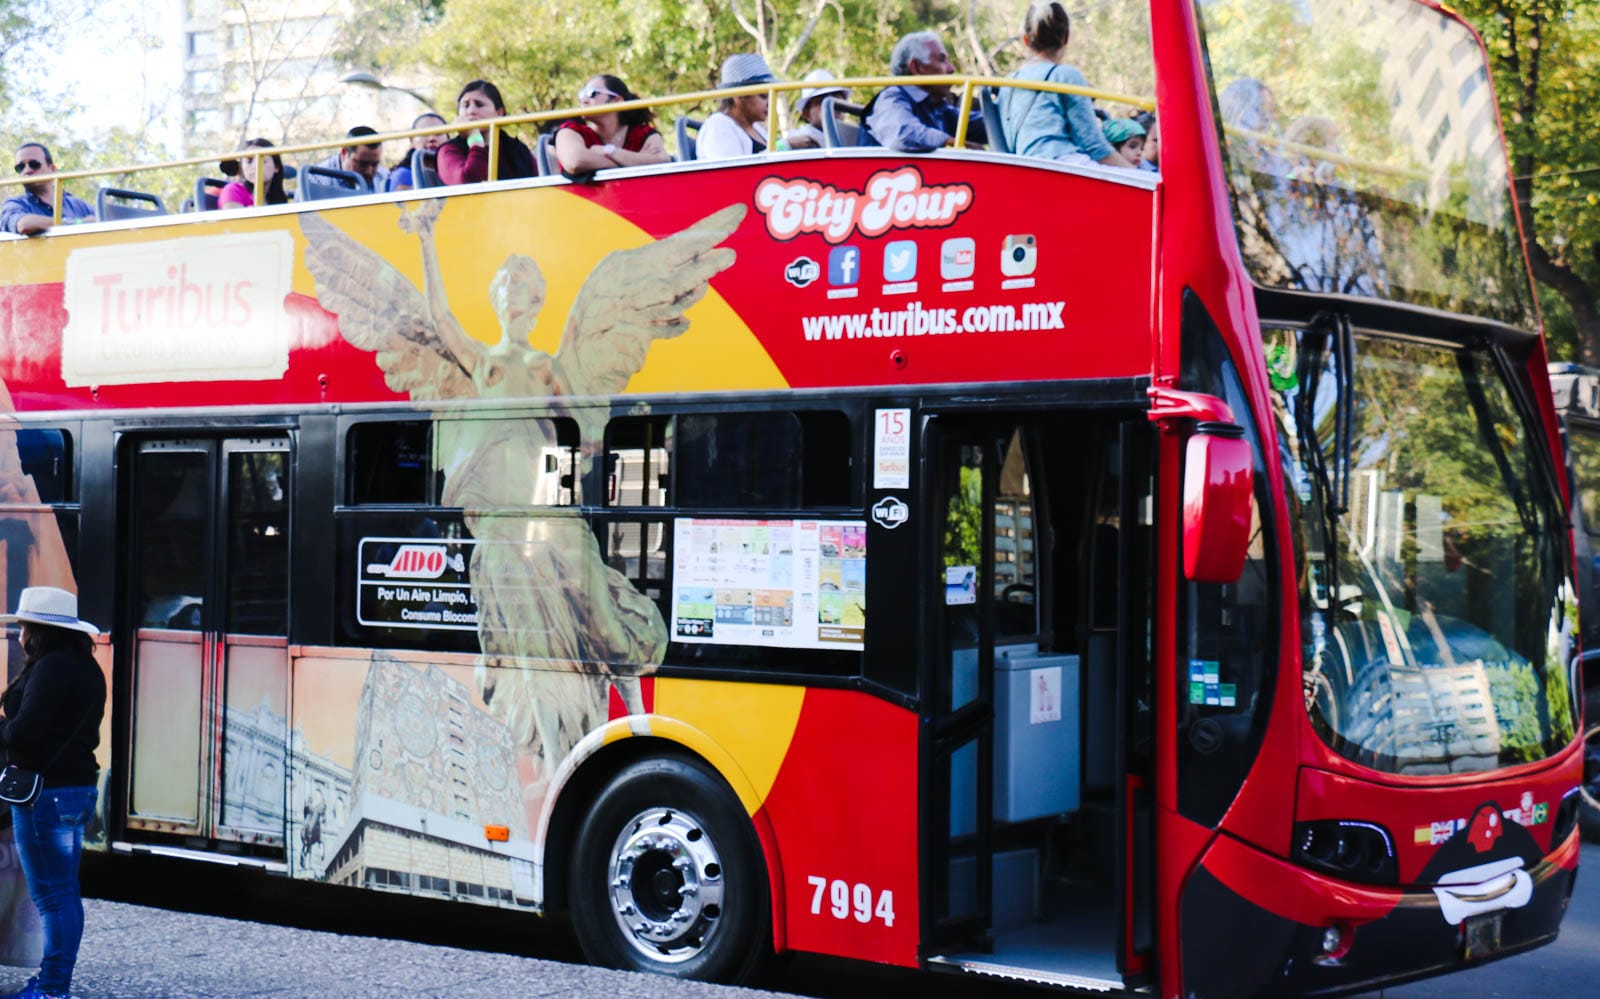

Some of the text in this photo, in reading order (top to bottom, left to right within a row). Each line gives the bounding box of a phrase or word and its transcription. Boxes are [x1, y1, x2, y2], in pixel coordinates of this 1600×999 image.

[757, 171, 969, 238] City Tour
[93, 262, 253, 334] Turibus
[801, 301, 1066, 341] www.turibus.com.mx
[880, 411, 905, 435] 15
[392, 550, 444, 572] ADO
[377, 587, 395, 600] Por
[396, 588, 409, 601] Un
[411, 589, 431, 602] Aire
[433, 590, 468, 605] Limpio,
[808, 875, 896, 928] 7994
